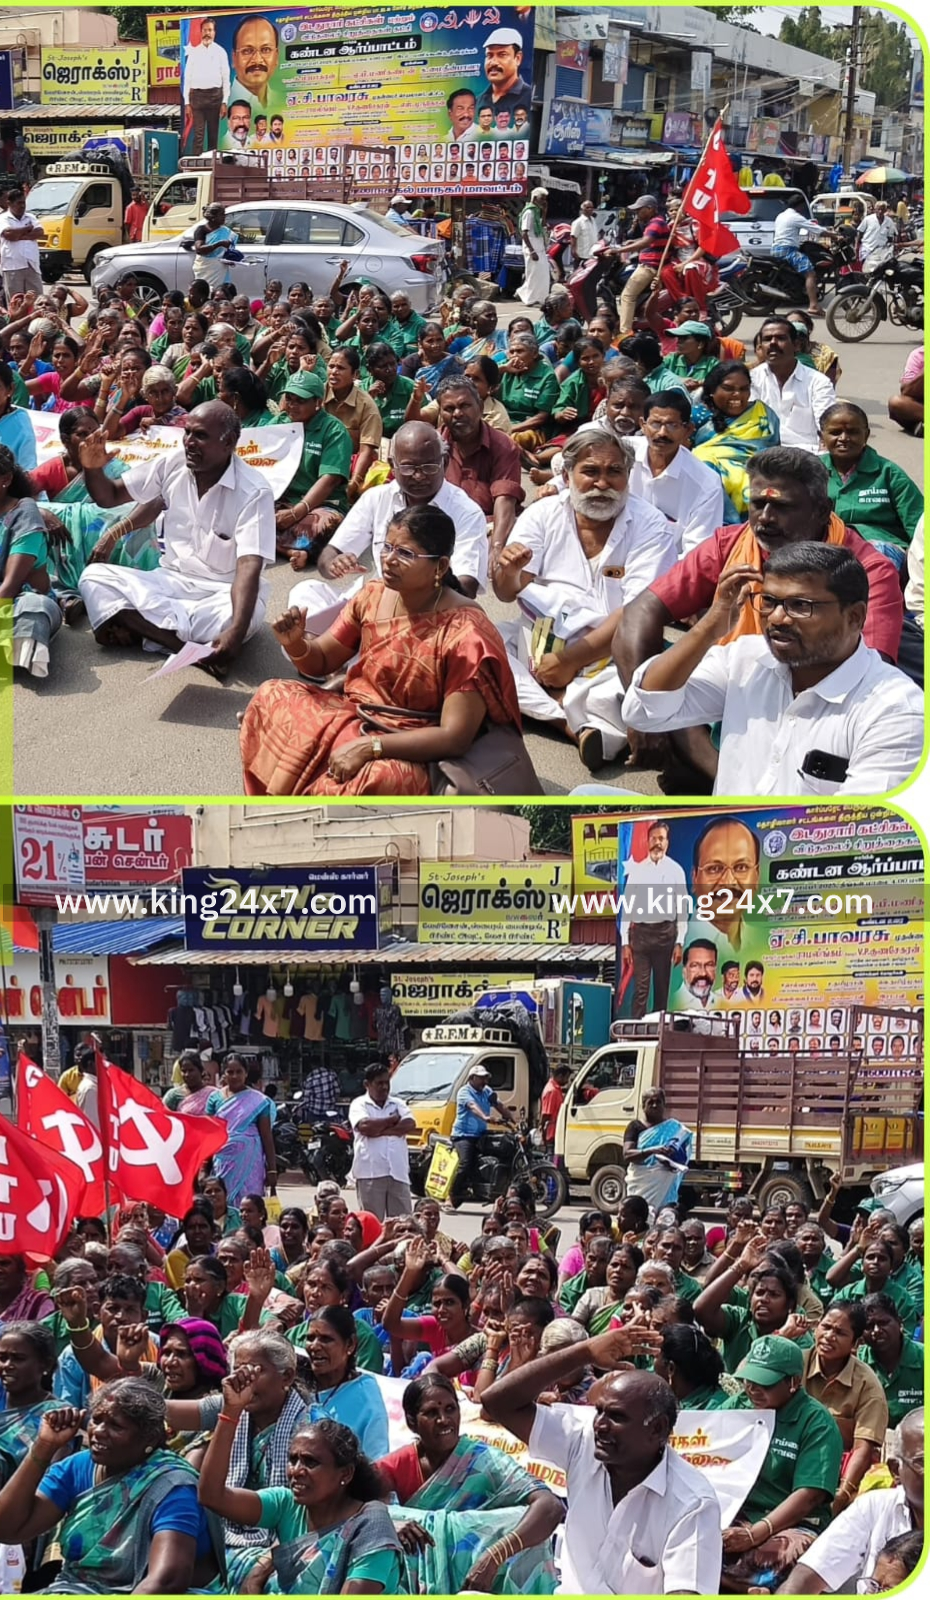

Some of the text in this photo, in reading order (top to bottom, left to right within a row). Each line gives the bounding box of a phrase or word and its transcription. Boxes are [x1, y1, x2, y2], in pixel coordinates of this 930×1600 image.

[290, 46, 336, 59] கண்டன
[339, 37, 417, 56] ஆர்ப்பாட்டம்
[43, 58, 130, 85] ஜெராக்ஸ்
[464, 183, 522, 194] மாவட்டம்
[789, 822, 856, 842] இடதுசாரி
[113, 852, 169, 870] சென்டர்
[776, 862, 843, 880] கண்டன
[422, 878, 546, 915] ஜெராக்ஸ்
[202, 915, 359, 940] CORNER
